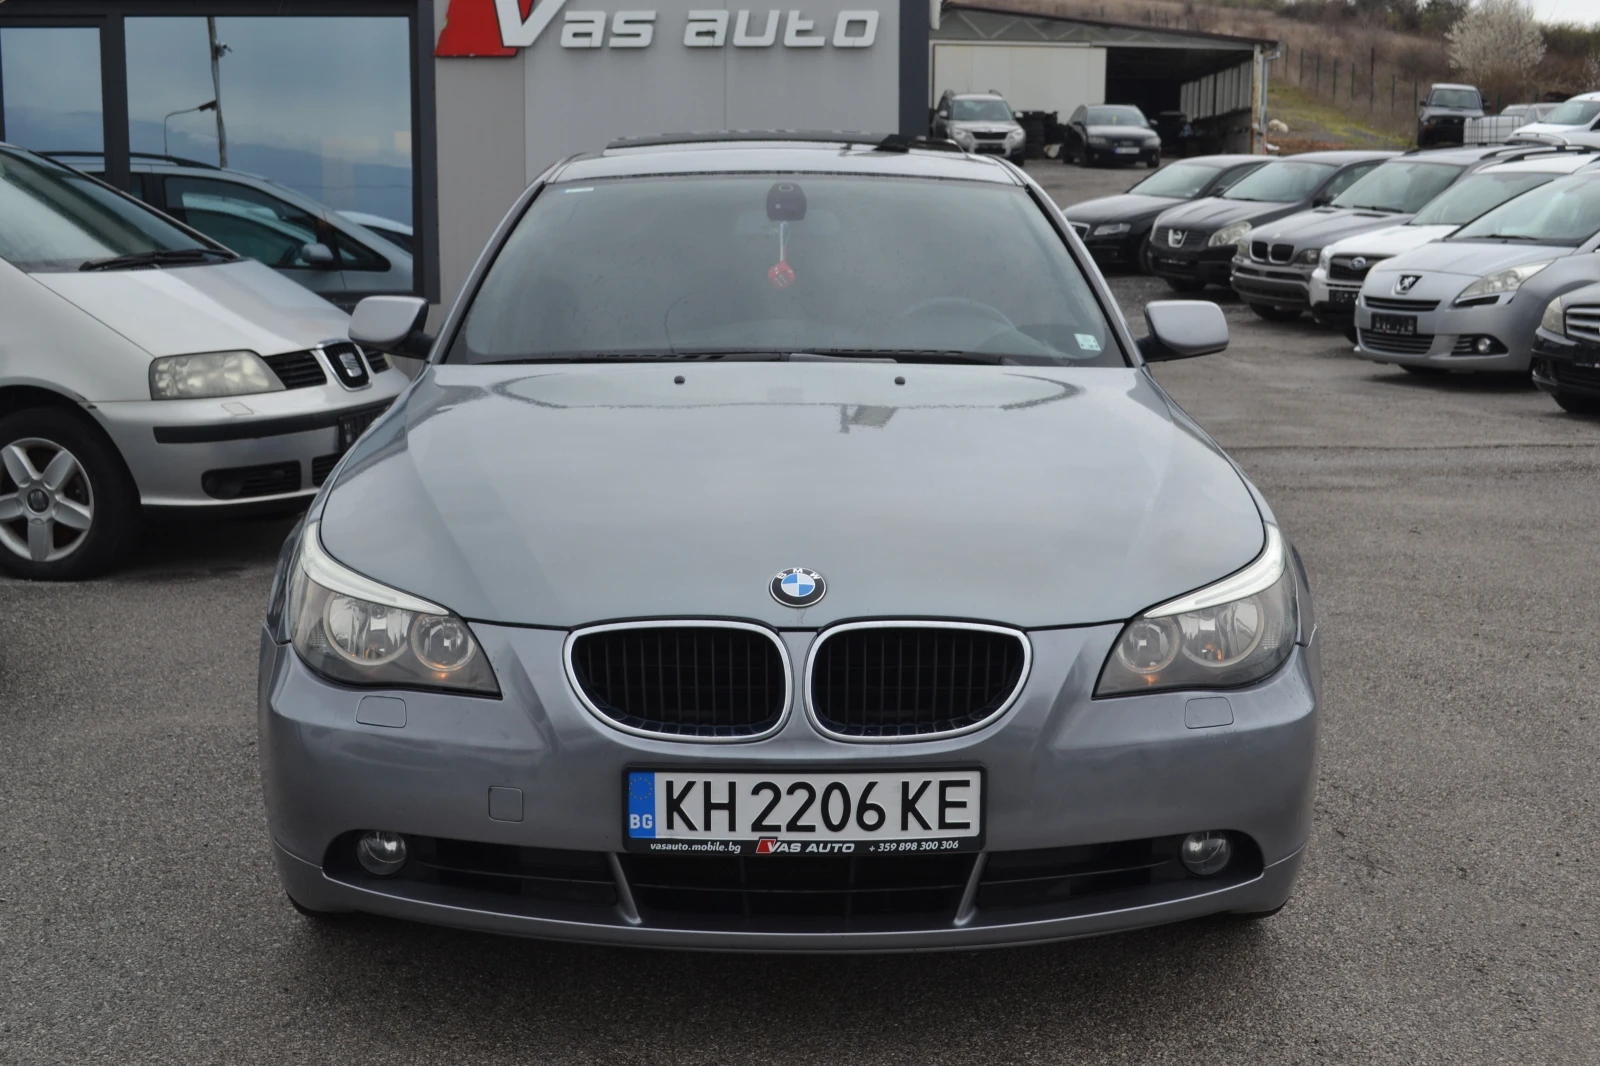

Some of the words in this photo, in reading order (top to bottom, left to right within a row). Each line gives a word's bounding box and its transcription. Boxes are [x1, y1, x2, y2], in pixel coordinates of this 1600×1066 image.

[776, 567, 821, 580] BMW
[665, 780, 737, 832] KH
[750, 781, 886, 833] 2206
[900, 779, 971, 831] KE
[629, 813, 653, 829] BG
[650, 841, 741, 854] vasauto.mobile.bg
[767, 841, 802, 853] VAS
[805, 843, 855, 853] AUTO
[898, 842, 917, 851] 898
[919, 841, 939, 851] 300
[940, 840, 959, 850] 306
